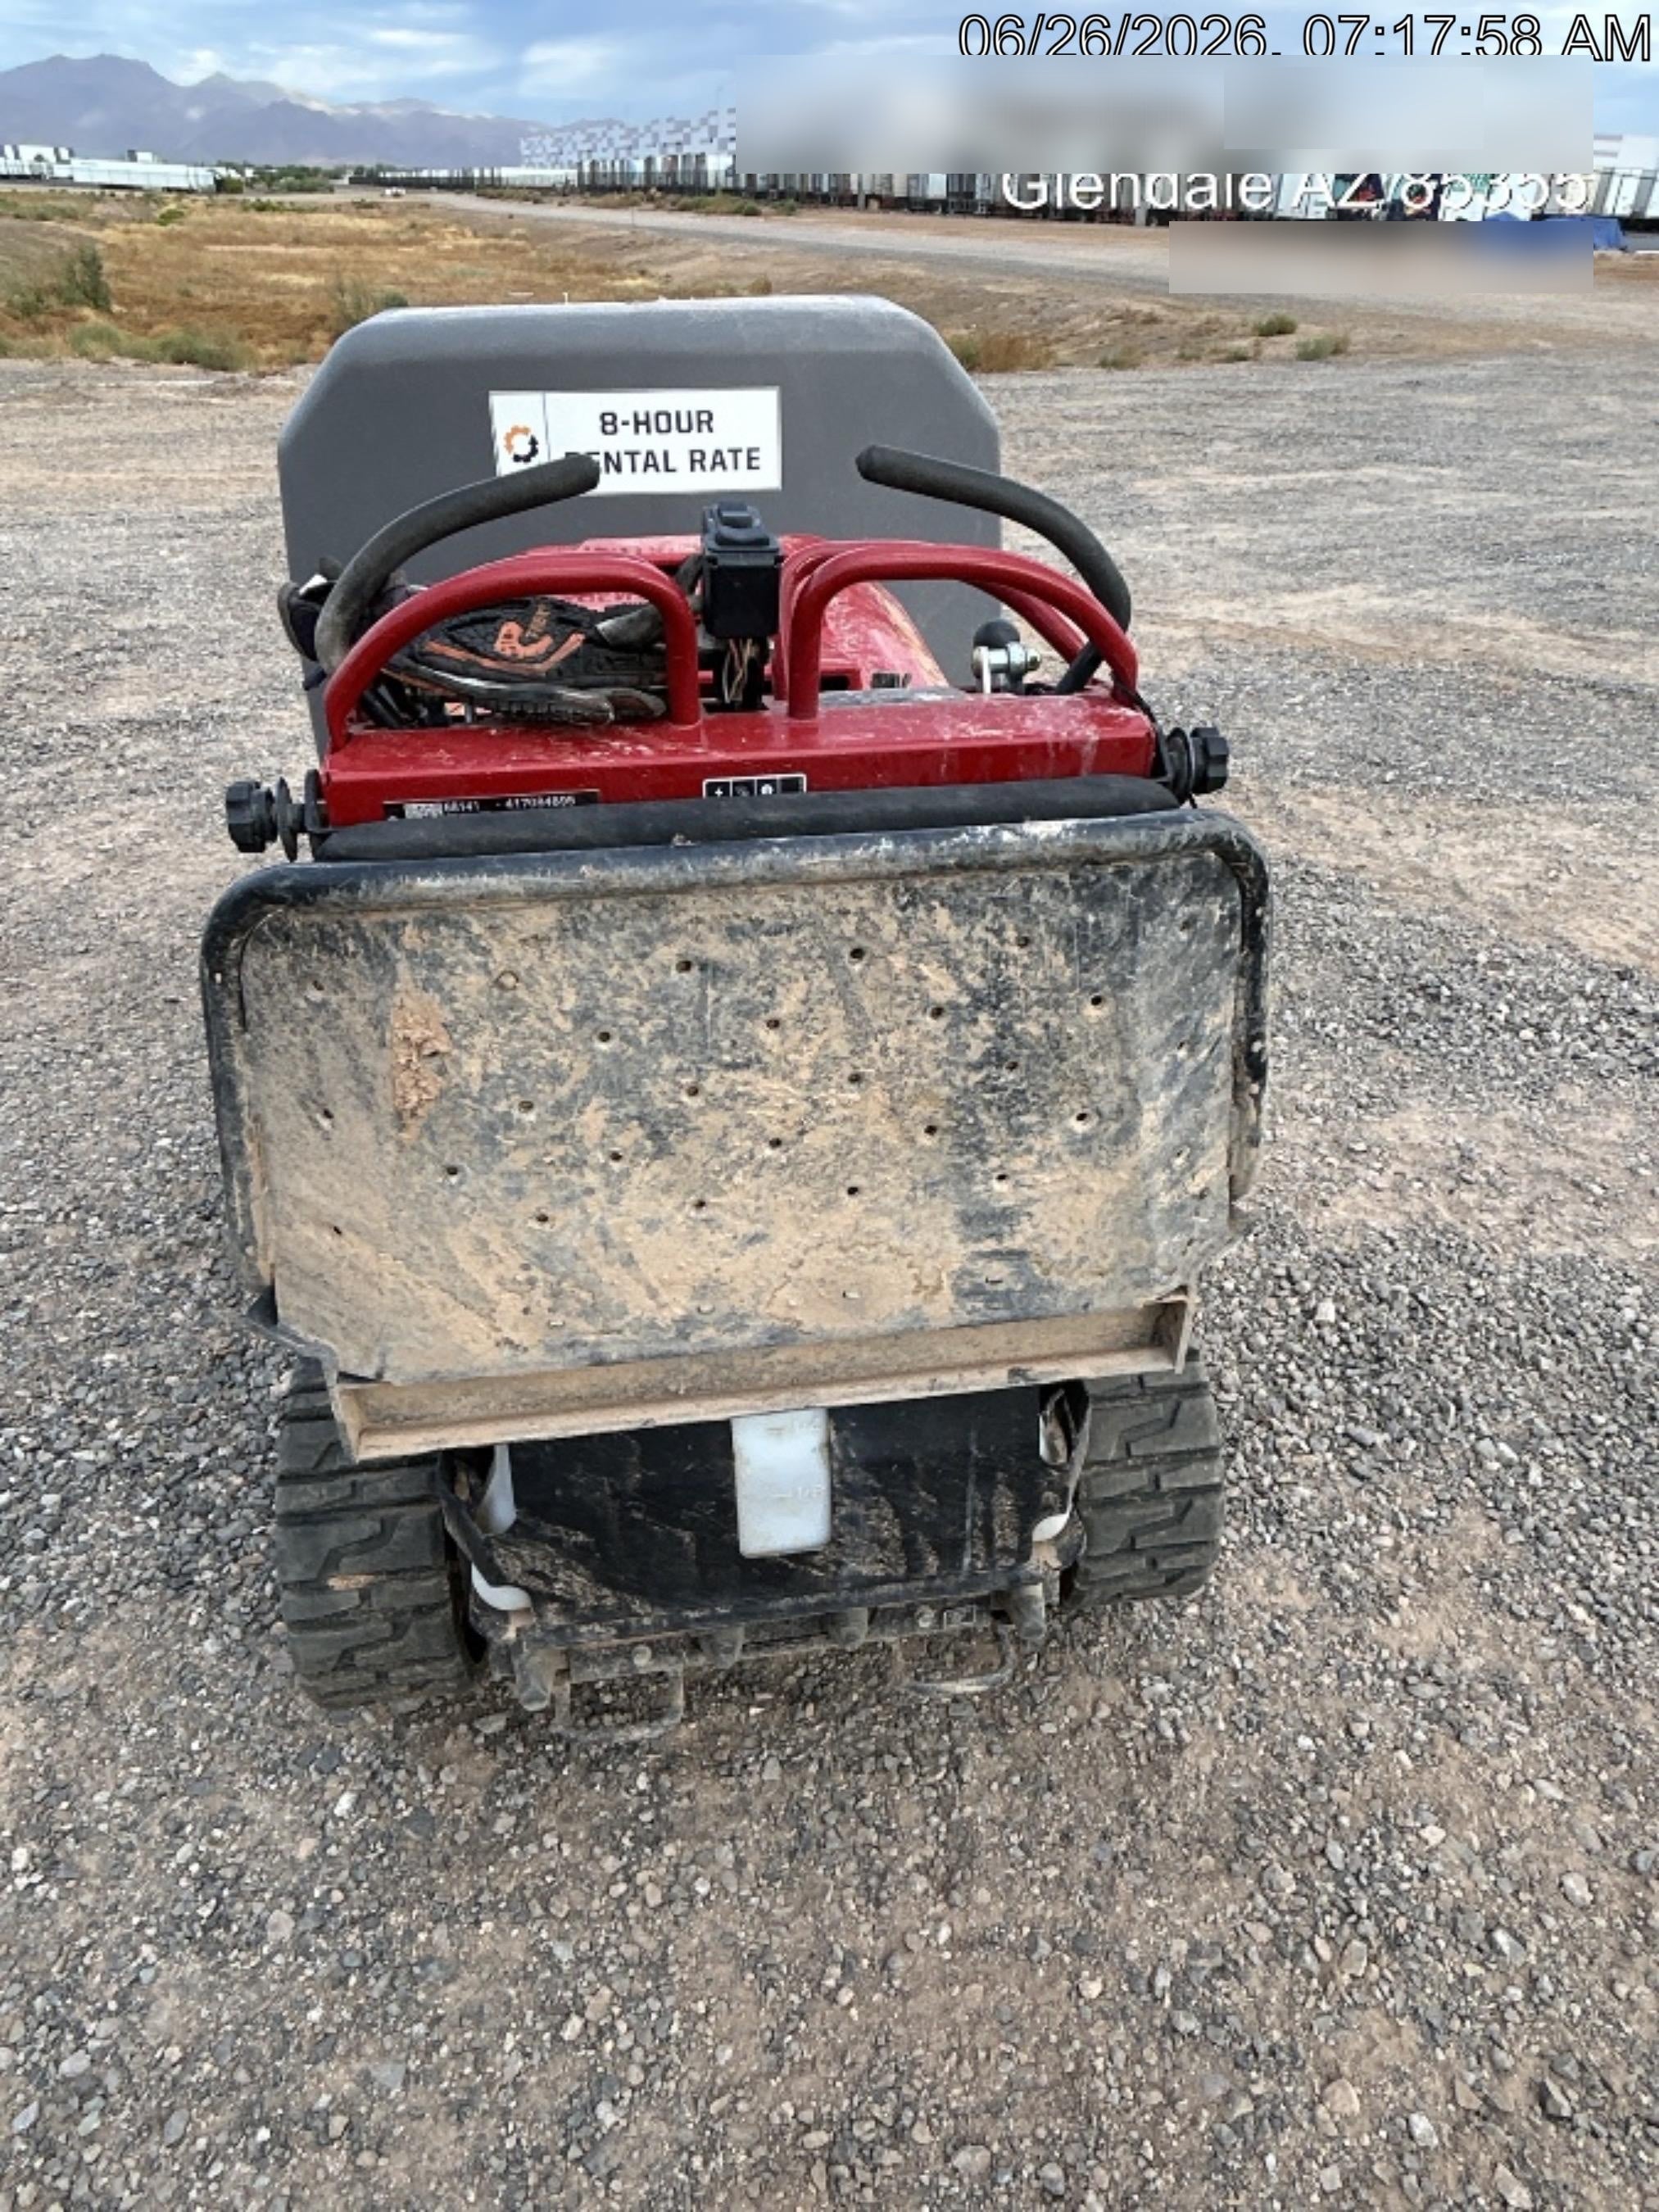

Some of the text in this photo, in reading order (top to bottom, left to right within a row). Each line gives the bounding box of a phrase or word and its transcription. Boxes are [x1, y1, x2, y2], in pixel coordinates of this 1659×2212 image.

[599, 410, 714, 435] 8-HOUR
[564, 446, 760, 474] NTAL RATE
